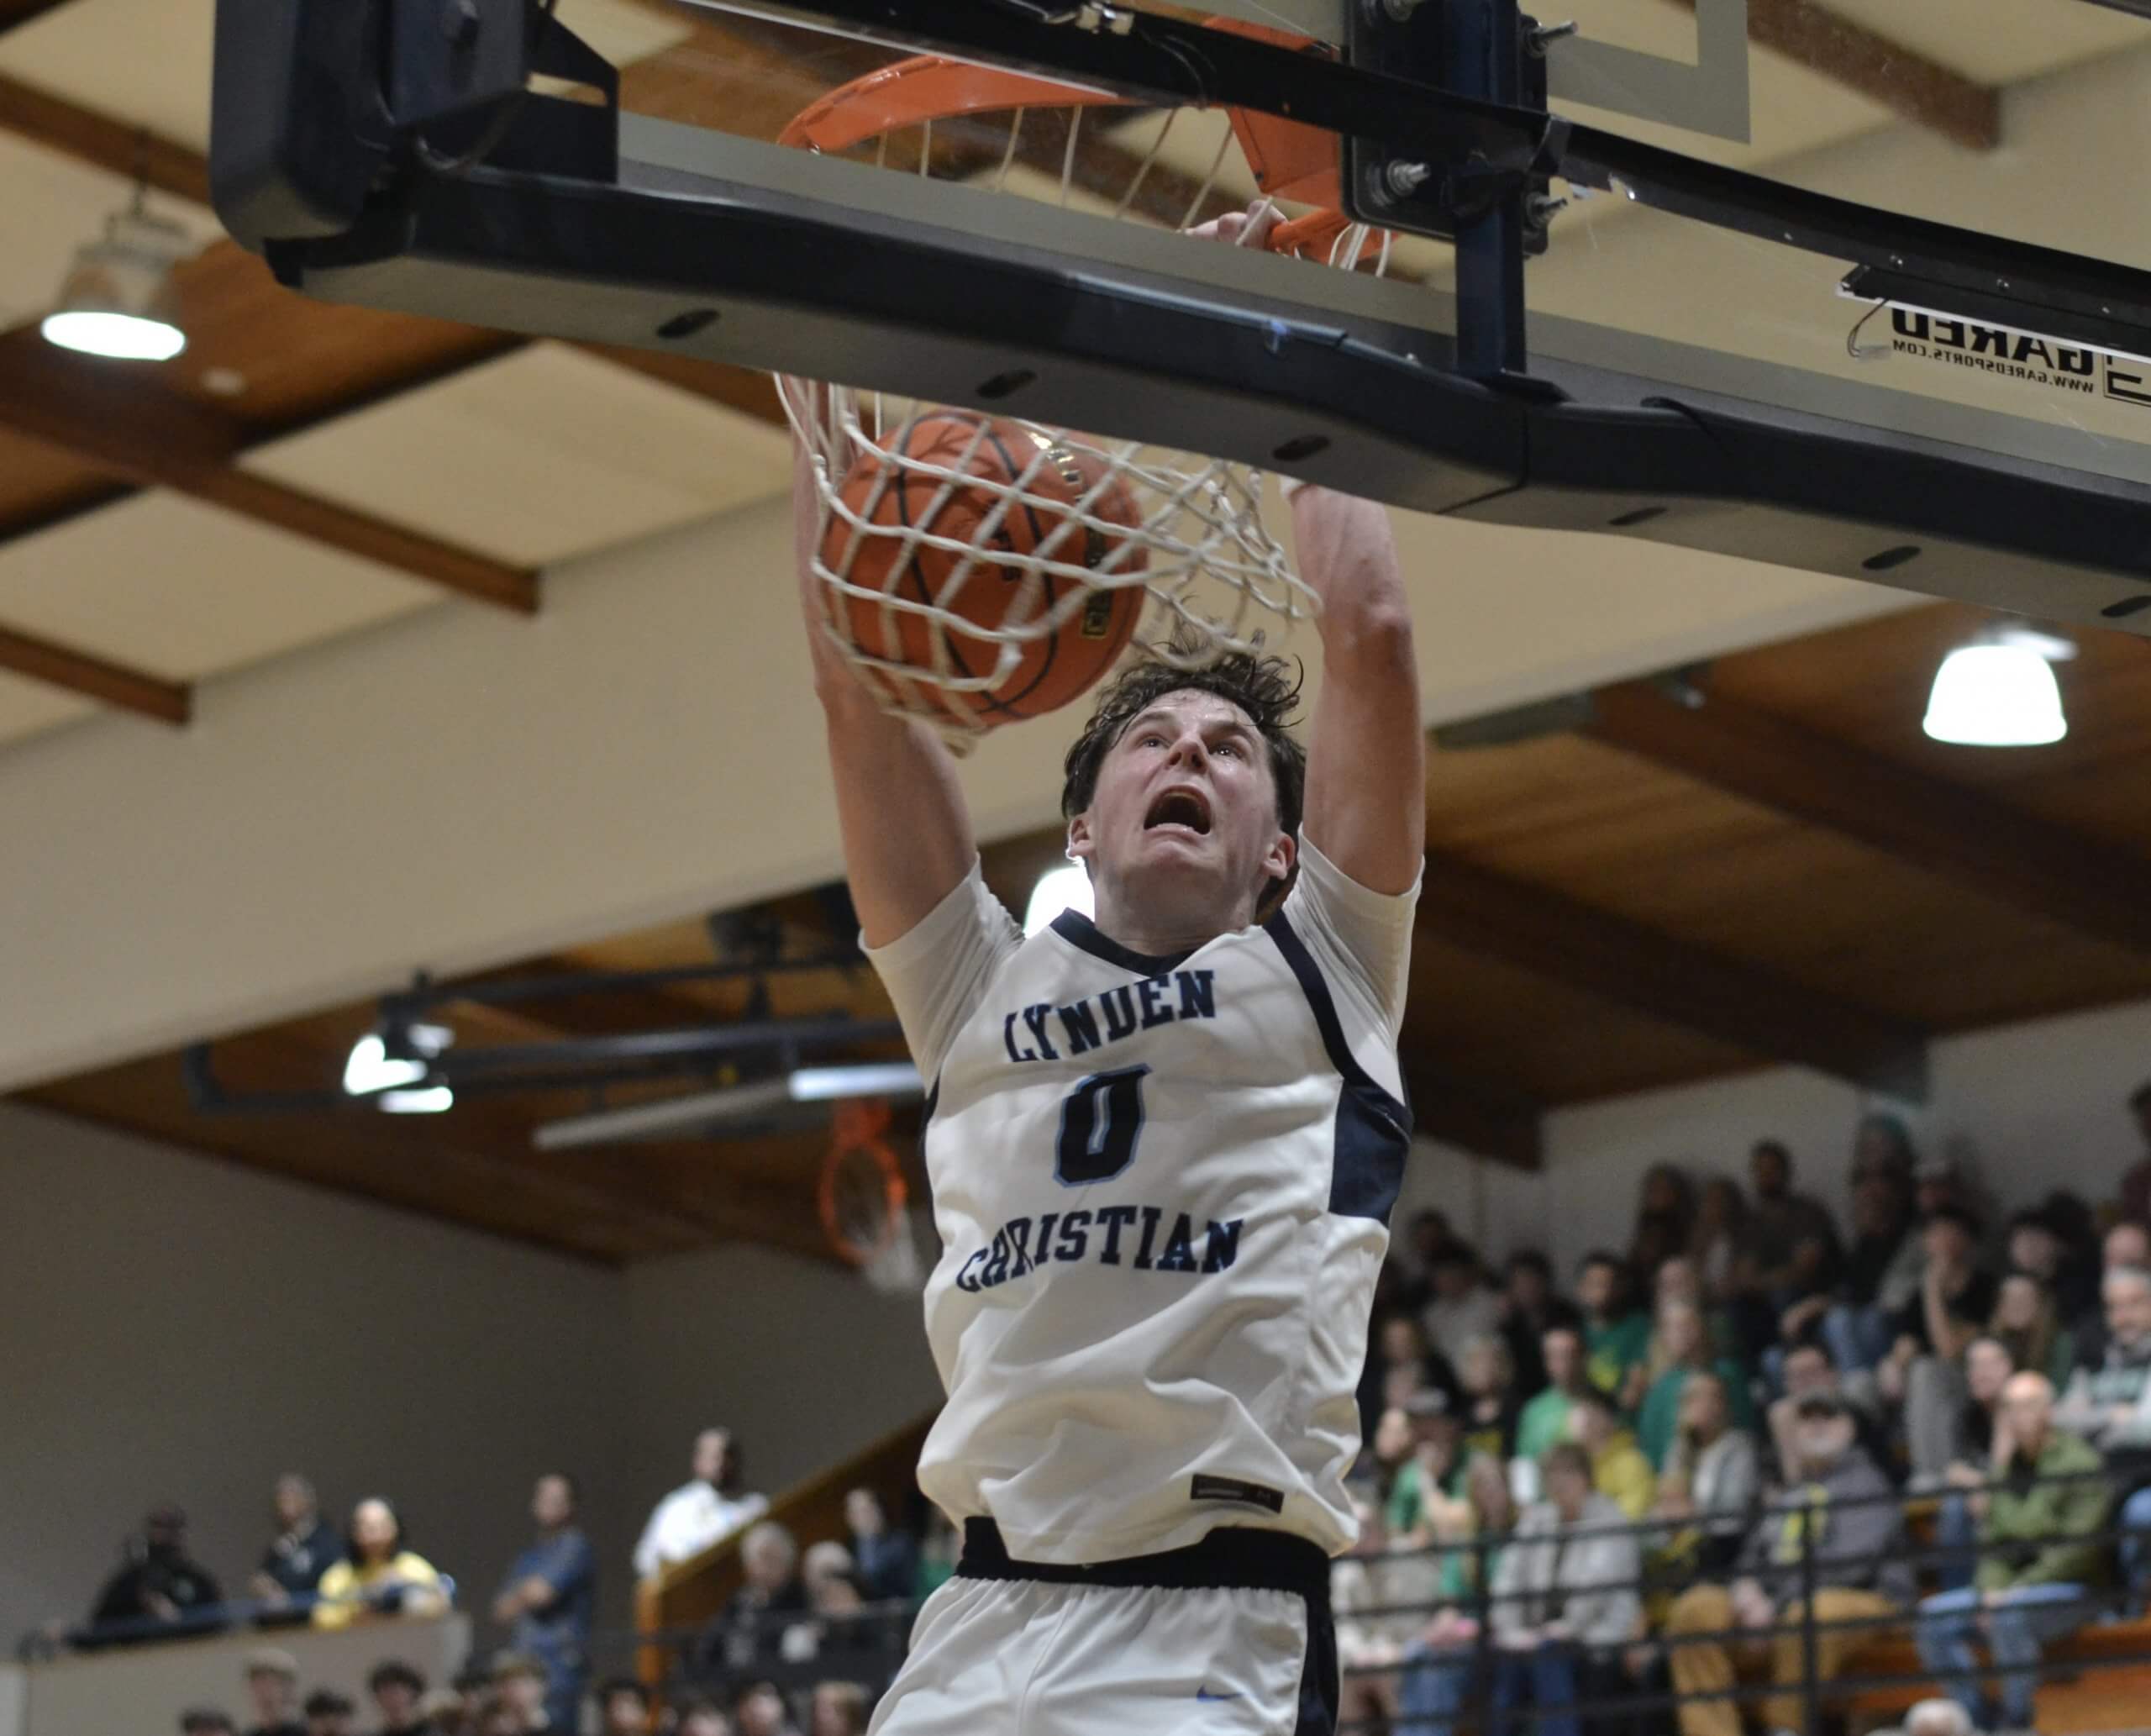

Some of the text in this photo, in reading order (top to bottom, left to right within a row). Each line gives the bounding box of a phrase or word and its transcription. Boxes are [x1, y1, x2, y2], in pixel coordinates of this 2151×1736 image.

[1004, 970, 1217, 1063] LYNDEN
[1052, 1062, 1153, 1188] 0
[955, 1205, 1244, 1293] CHRISTIAN
